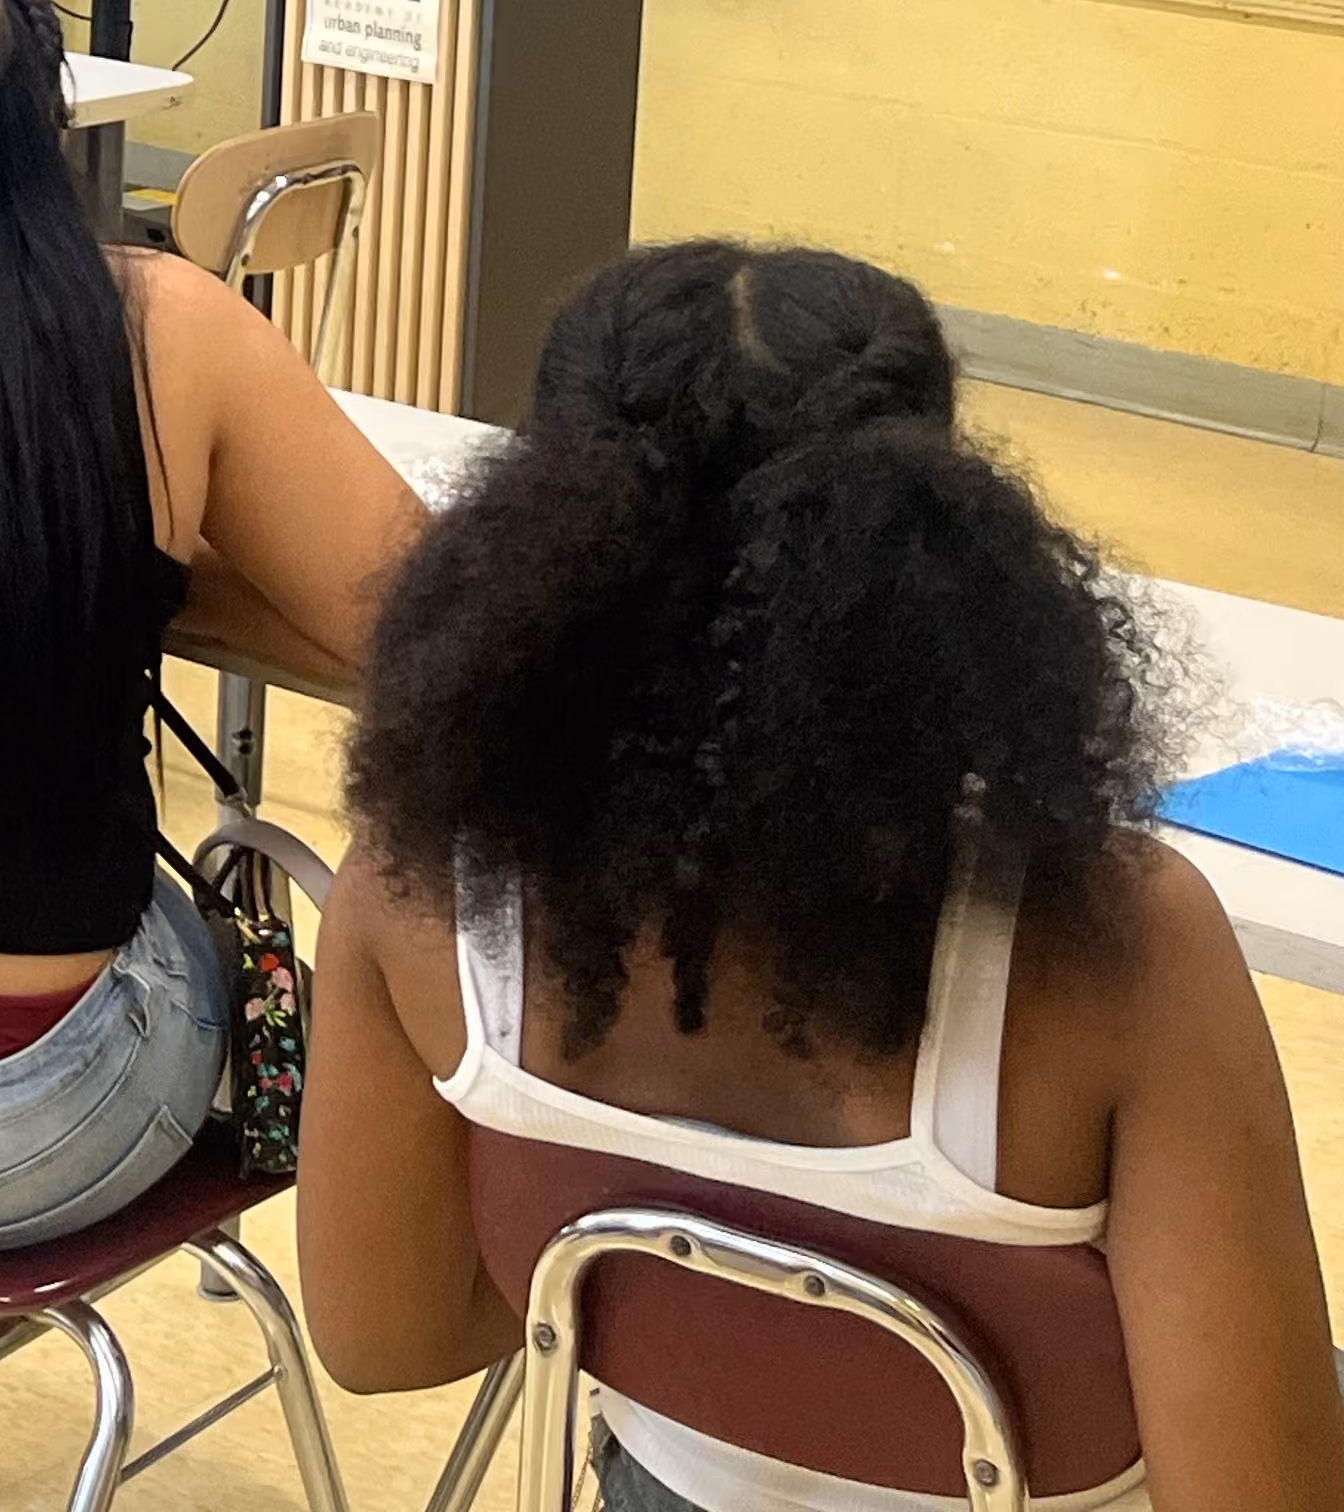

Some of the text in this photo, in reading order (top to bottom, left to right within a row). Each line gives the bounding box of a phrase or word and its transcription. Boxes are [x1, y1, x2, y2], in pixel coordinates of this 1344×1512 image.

[323, 12, 422, 52] urban planning
[318, 39, 419, 74] and engineering
